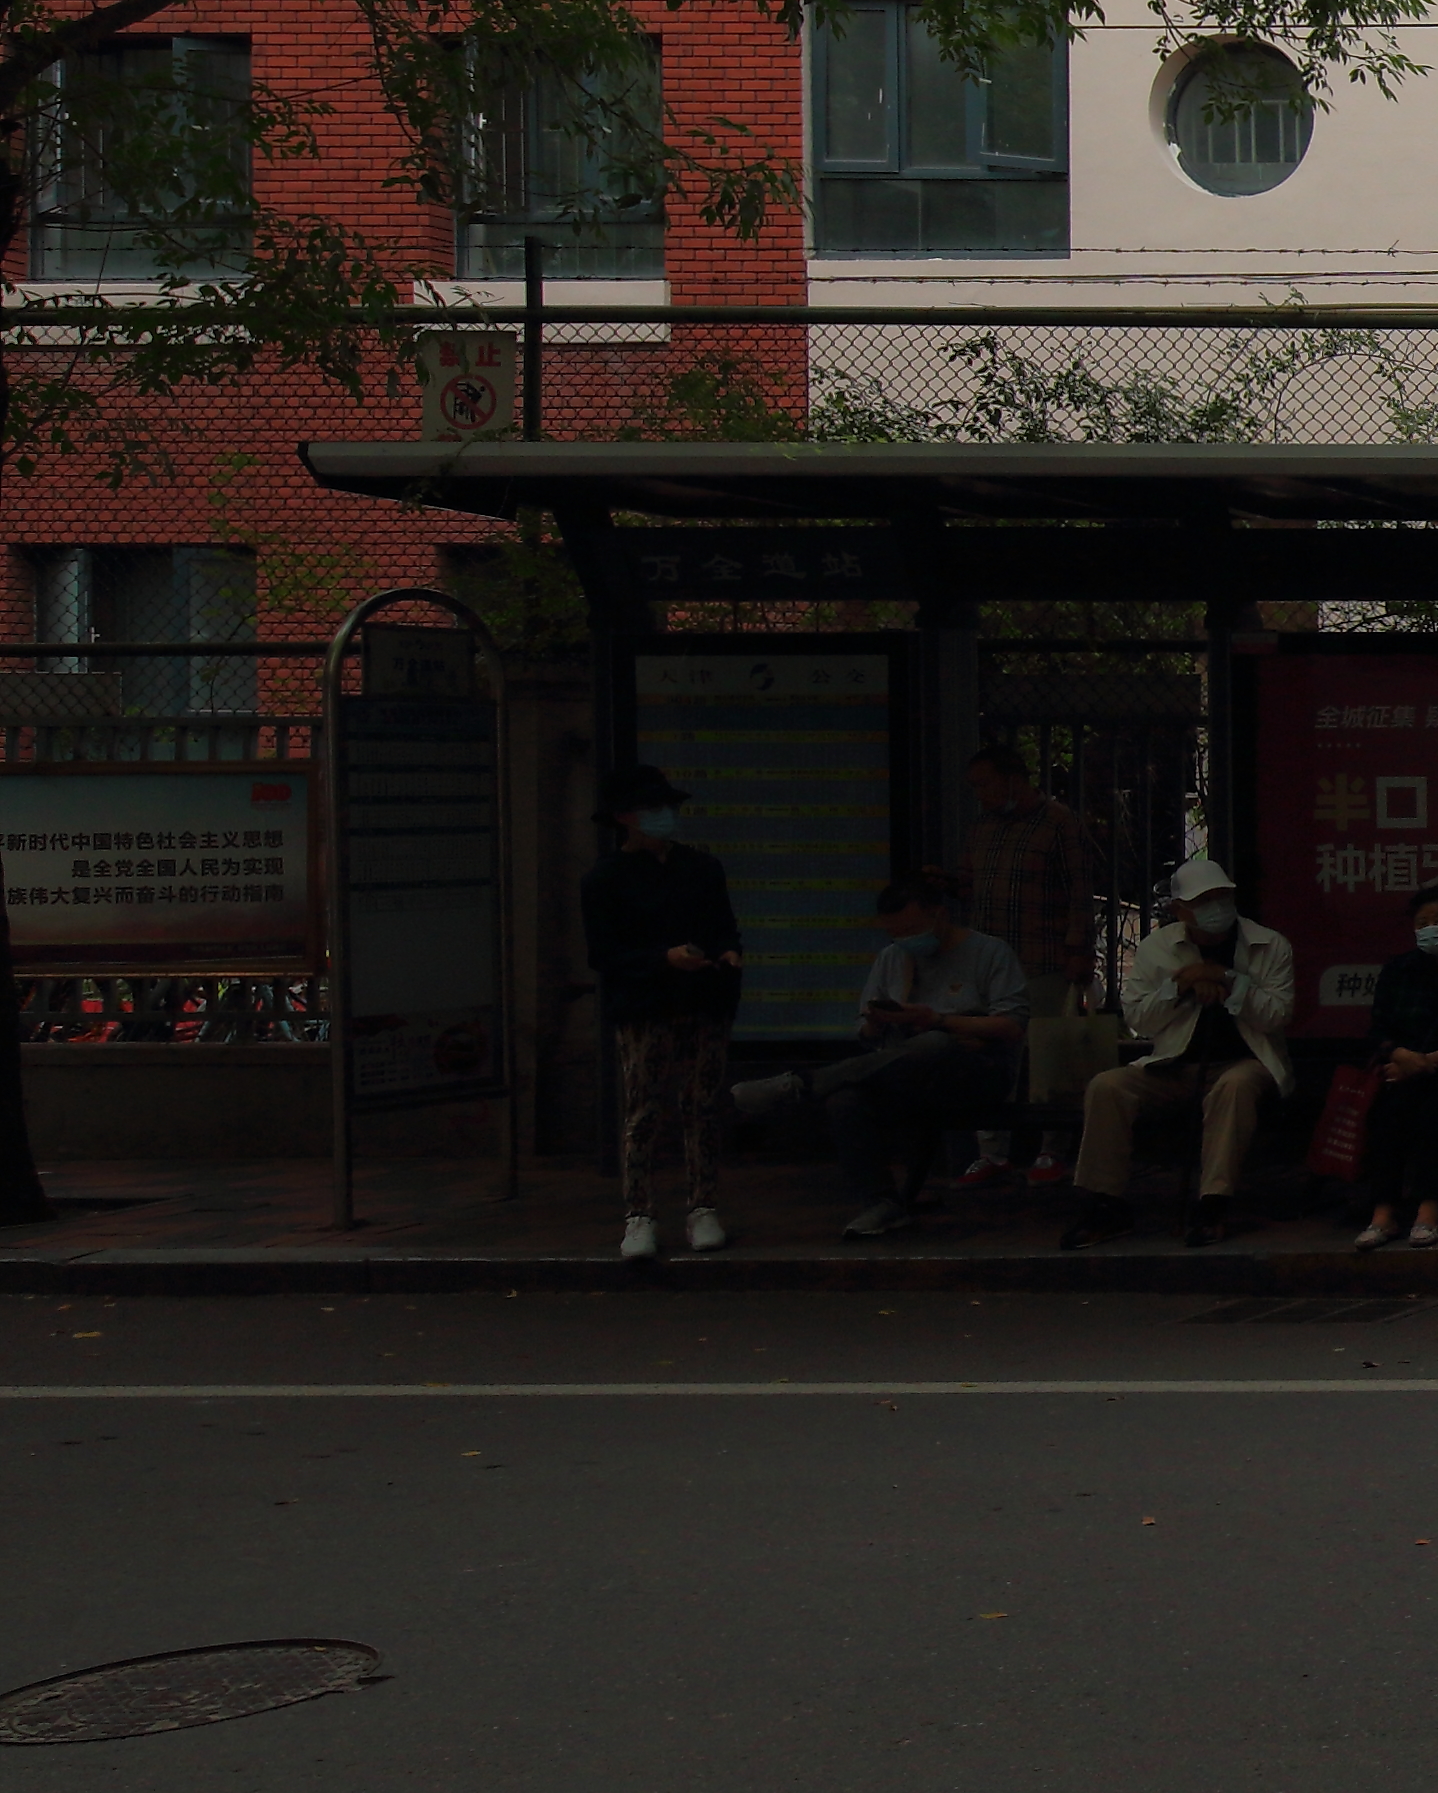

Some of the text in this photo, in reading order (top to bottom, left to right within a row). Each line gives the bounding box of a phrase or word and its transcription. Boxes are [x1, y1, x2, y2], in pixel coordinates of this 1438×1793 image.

[641, 550, 864, 582] 万全道站
[1314, 705, 1415, 729] 全城征集
[71, 858, 285, 879] 是全党全国人民为实现
